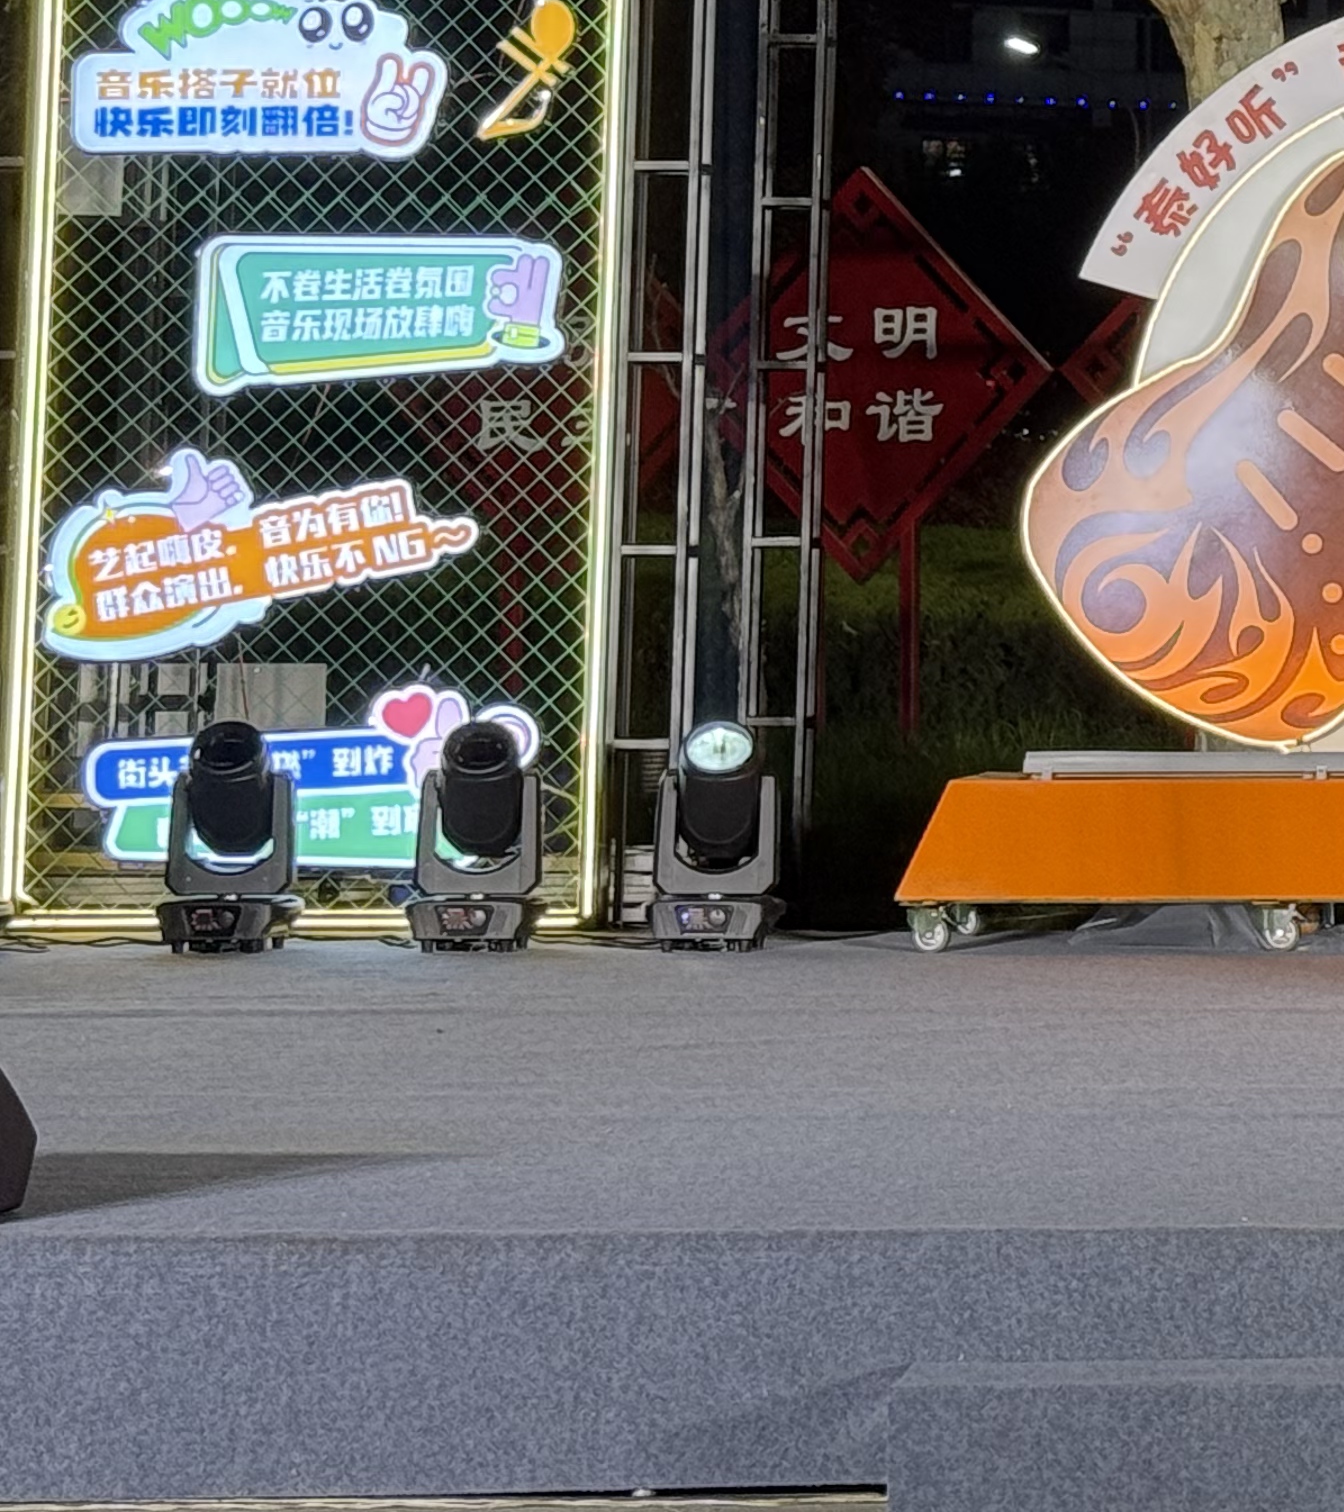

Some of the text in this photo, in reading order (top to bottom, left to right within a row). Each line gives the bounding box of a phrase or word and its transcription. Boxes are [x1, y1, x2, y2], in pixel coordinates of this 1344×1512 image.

[96, 68, 341, 100] 音乐搭子就位
[260, 266, 474, 303] 不卷生活卷氛围
[260, 303, 474, 342] 音乐现场放肆嗨
[776, 306, 938, 361] 文明
[778, 388, 944, 445] 和谐
